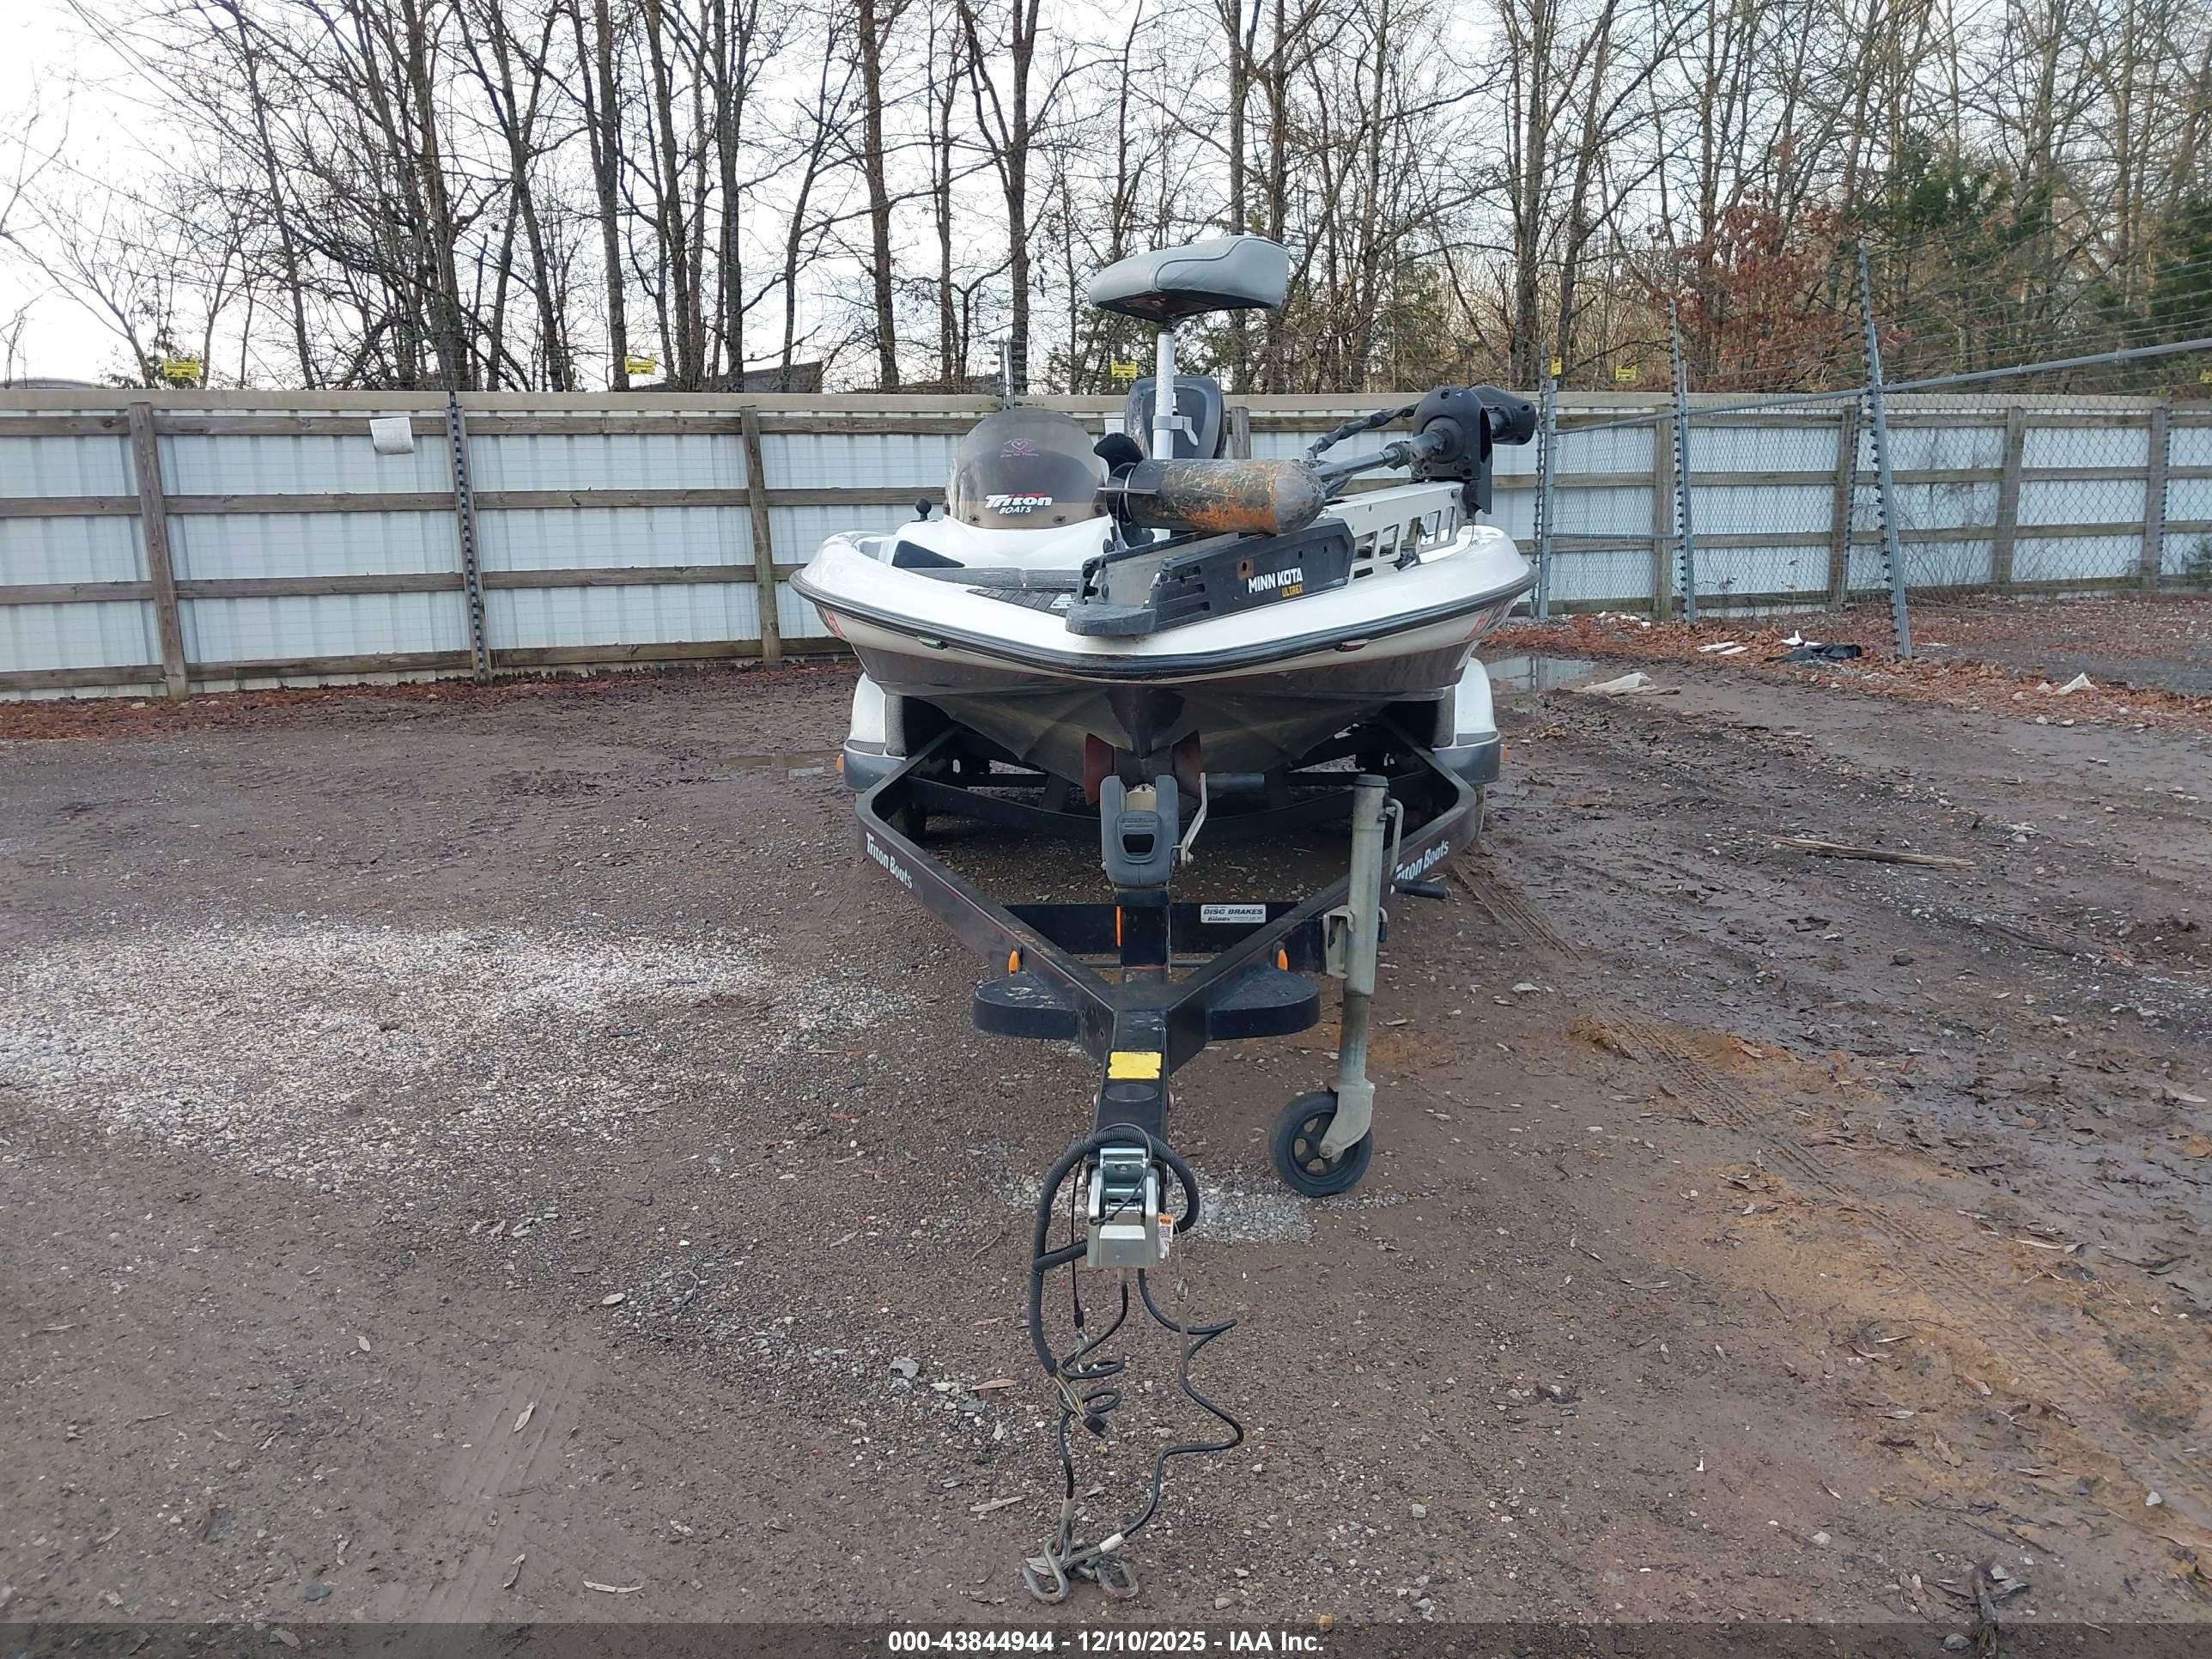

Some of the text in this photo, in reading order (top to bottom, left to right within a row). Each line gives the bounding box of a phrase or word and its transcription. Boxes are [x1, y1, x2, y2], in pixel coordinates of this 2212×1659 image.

[985, 492, 1053, 508] Triton
[999, 506, 1032, 514] BOATS
[1248, 567, 1304, 593] MINN KOTA
[866, 831, 913, 890] Triton Boats
[1423, 840, 1449, 871] Boats
